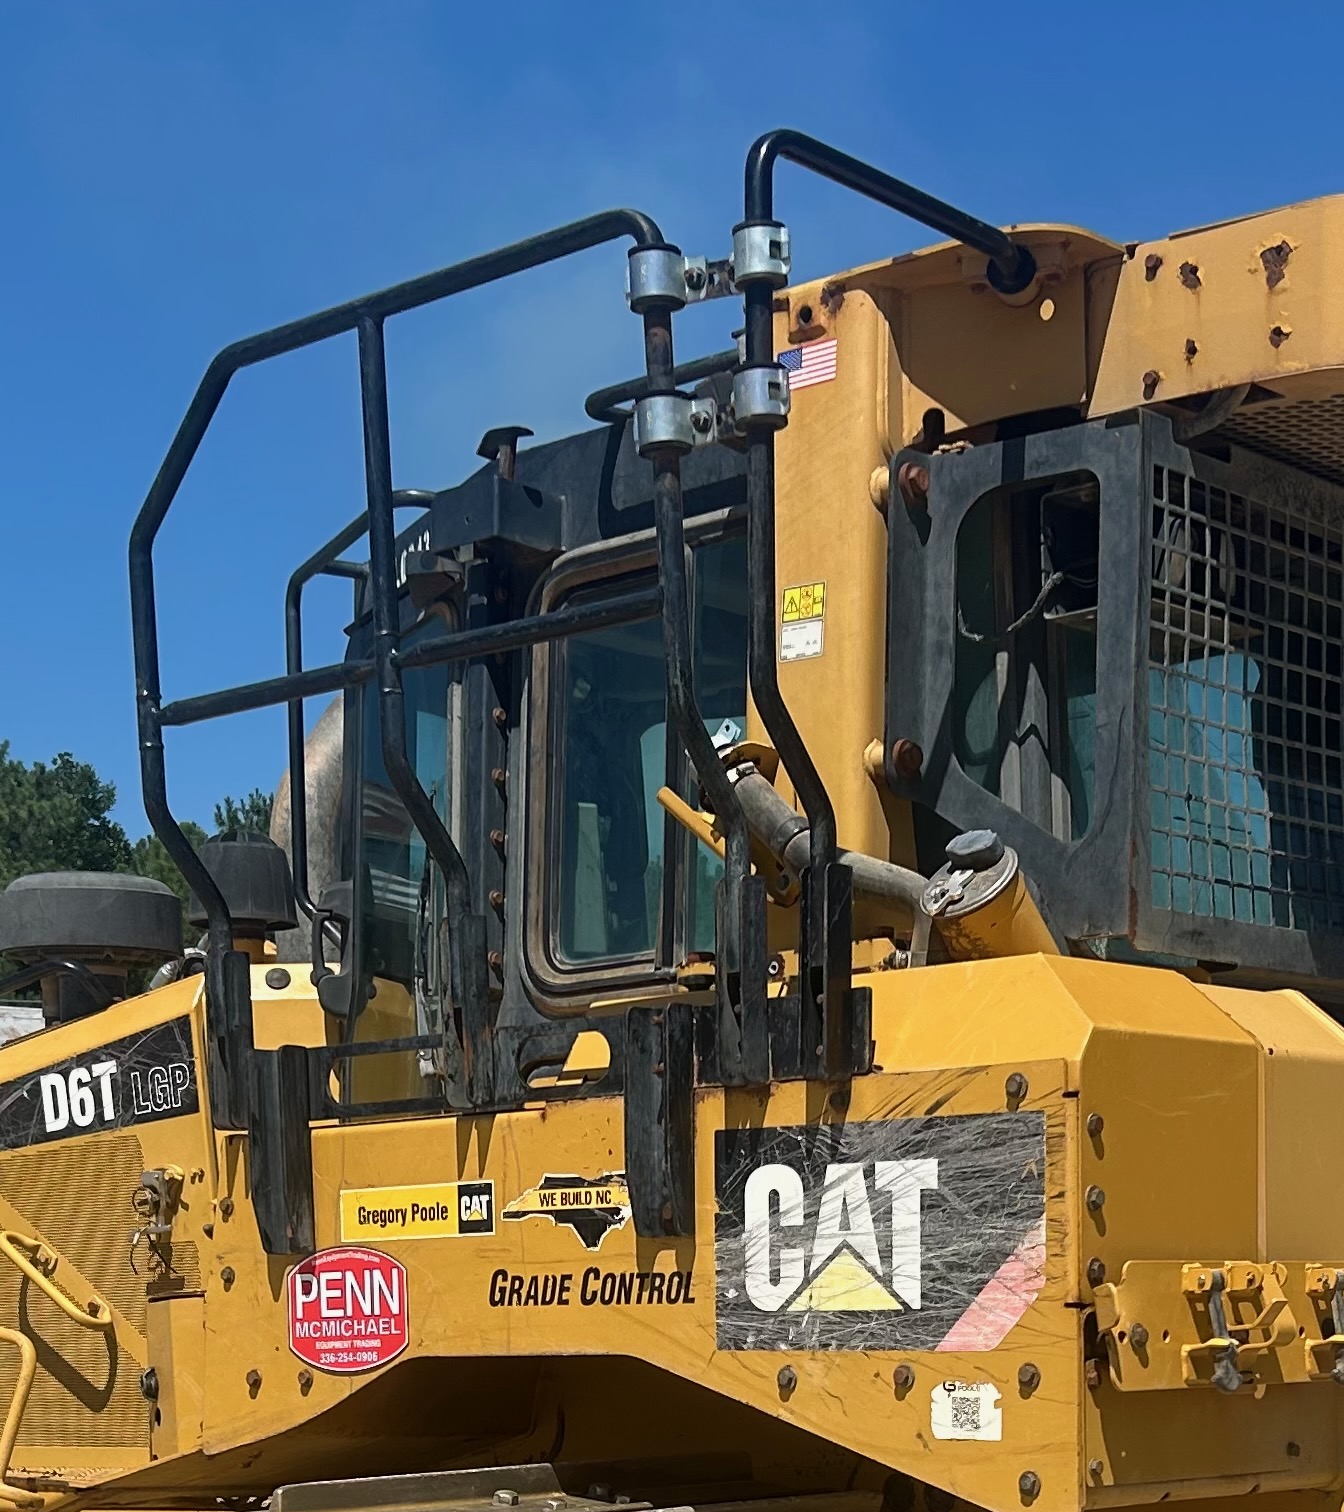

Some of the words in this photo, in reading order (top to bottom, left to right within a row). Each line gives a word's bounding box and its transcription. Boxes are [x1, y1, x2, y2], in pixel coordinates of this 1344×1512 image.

[40, 1059, 118, 1133] D6T
[131, 1062, 190, 1116] LGP
[357, 1205, 407, 1229] Gregory
[411, 1201, 449, 1222] Poole
[460, 1194, 490, 1222] CAT
[538, 1191, 557, 1207] WE
[560, 1190, 592, 1207] BUILD
[596, 1189, 612, 1205] NC
[743, 1157, 939, 1312] CAT
[295, 1267, 401, 1320] PENN
[489, 1268, 573, 1308] GRADE
[580, 1266, 696, 1306] CONTROL
[295, 1317, 402, 1338] MCMICHAEL
